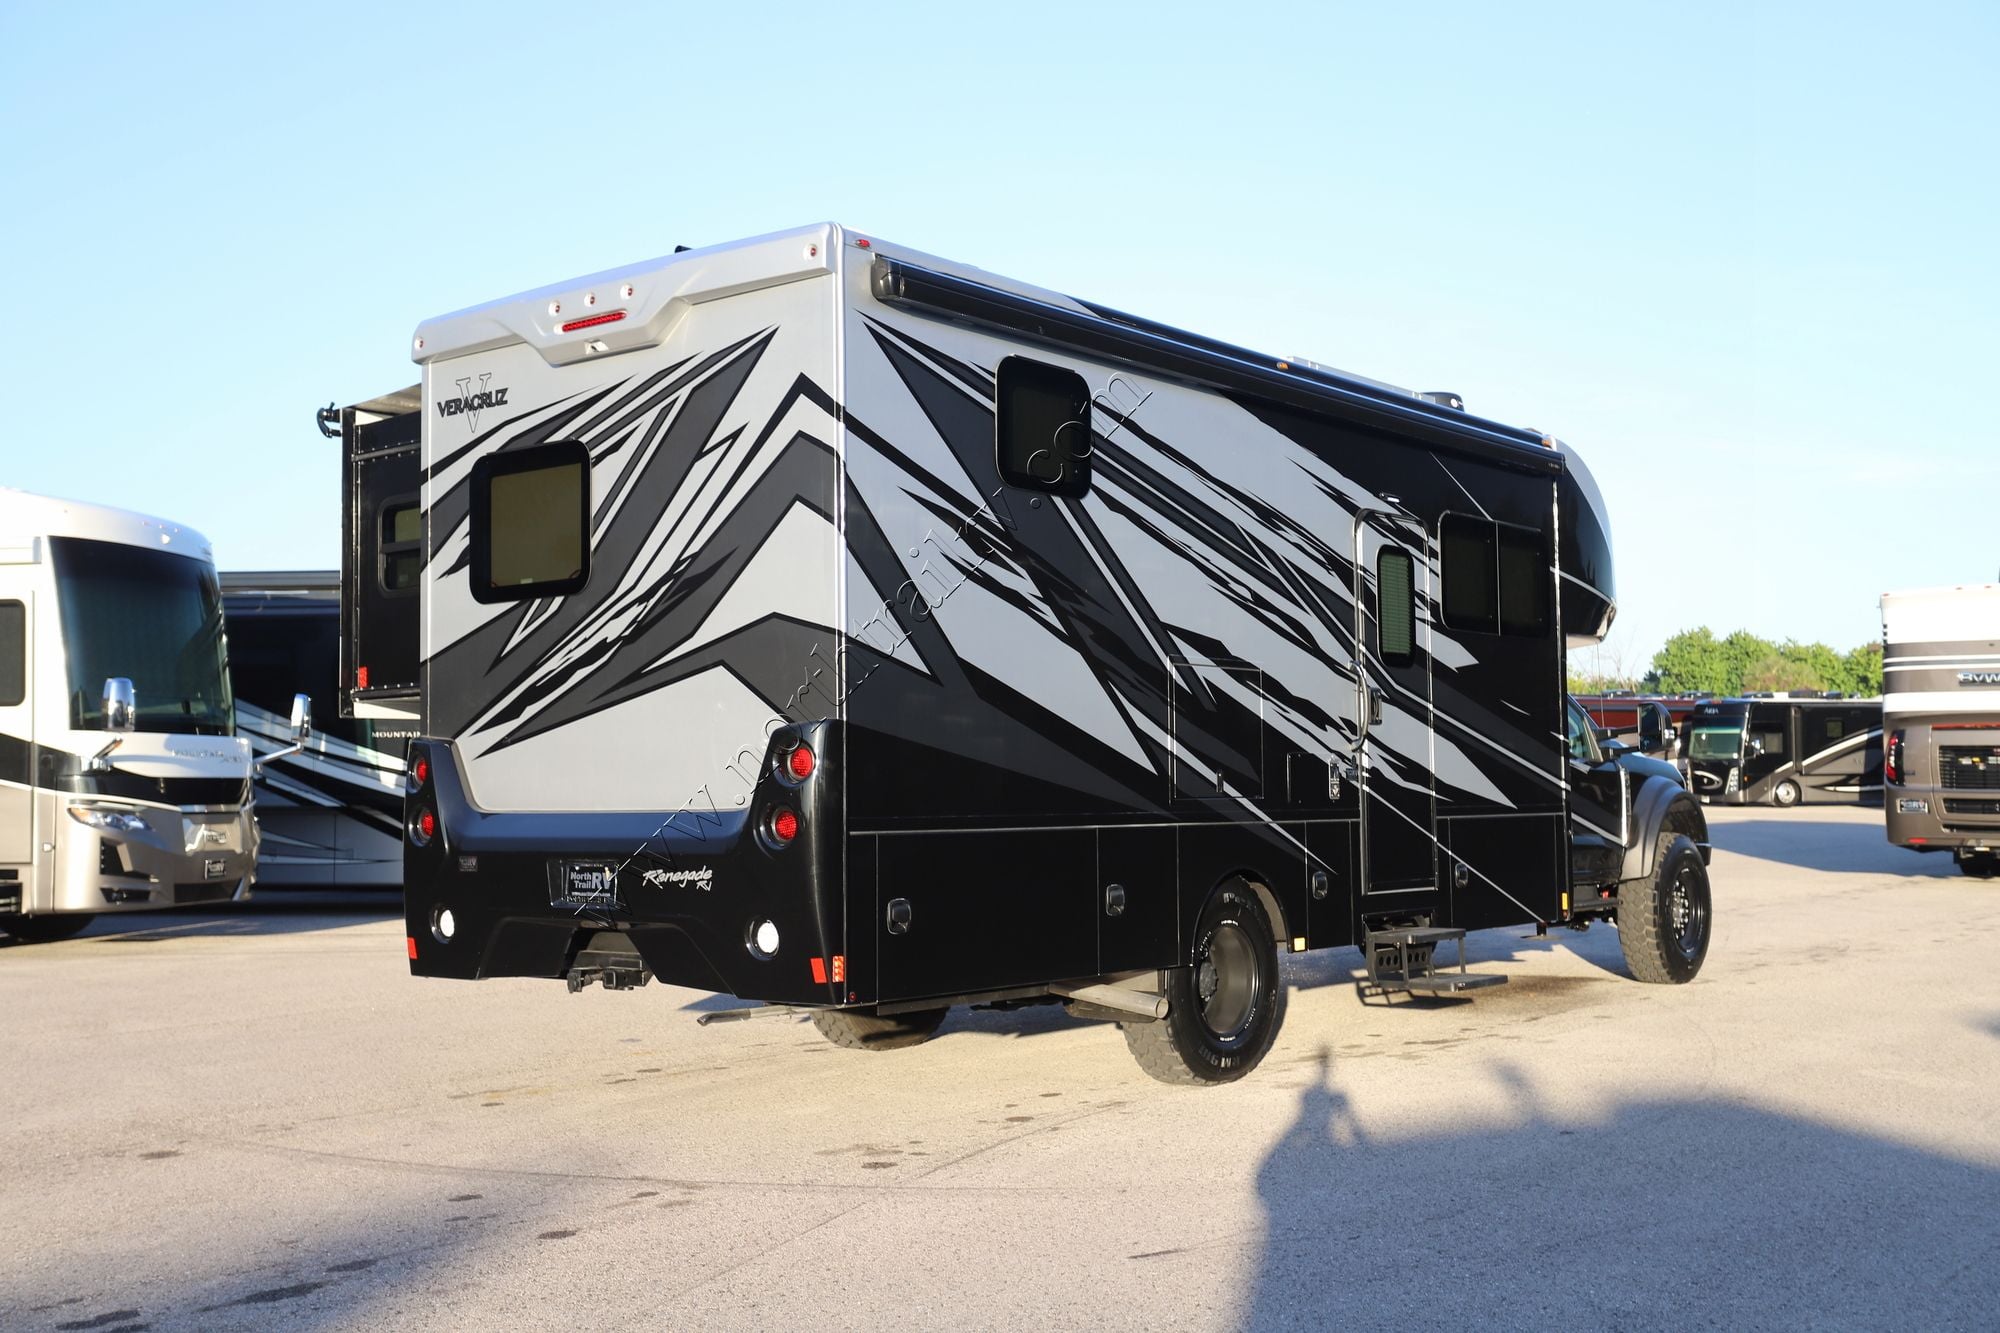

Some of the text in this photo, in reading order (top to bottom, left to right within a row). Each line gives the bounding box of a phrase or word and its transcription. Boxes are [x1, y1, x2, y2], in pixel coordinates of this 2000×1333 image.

[437, 387, 509, 418] VERACRUZ
[570, 871, 592, 881] North
[591, 872, 613, 890] RV
[642, 865, 713, 890] Renegade
[574, 880, 592, 889] Trail
[696, 880, 712, 892] RV
